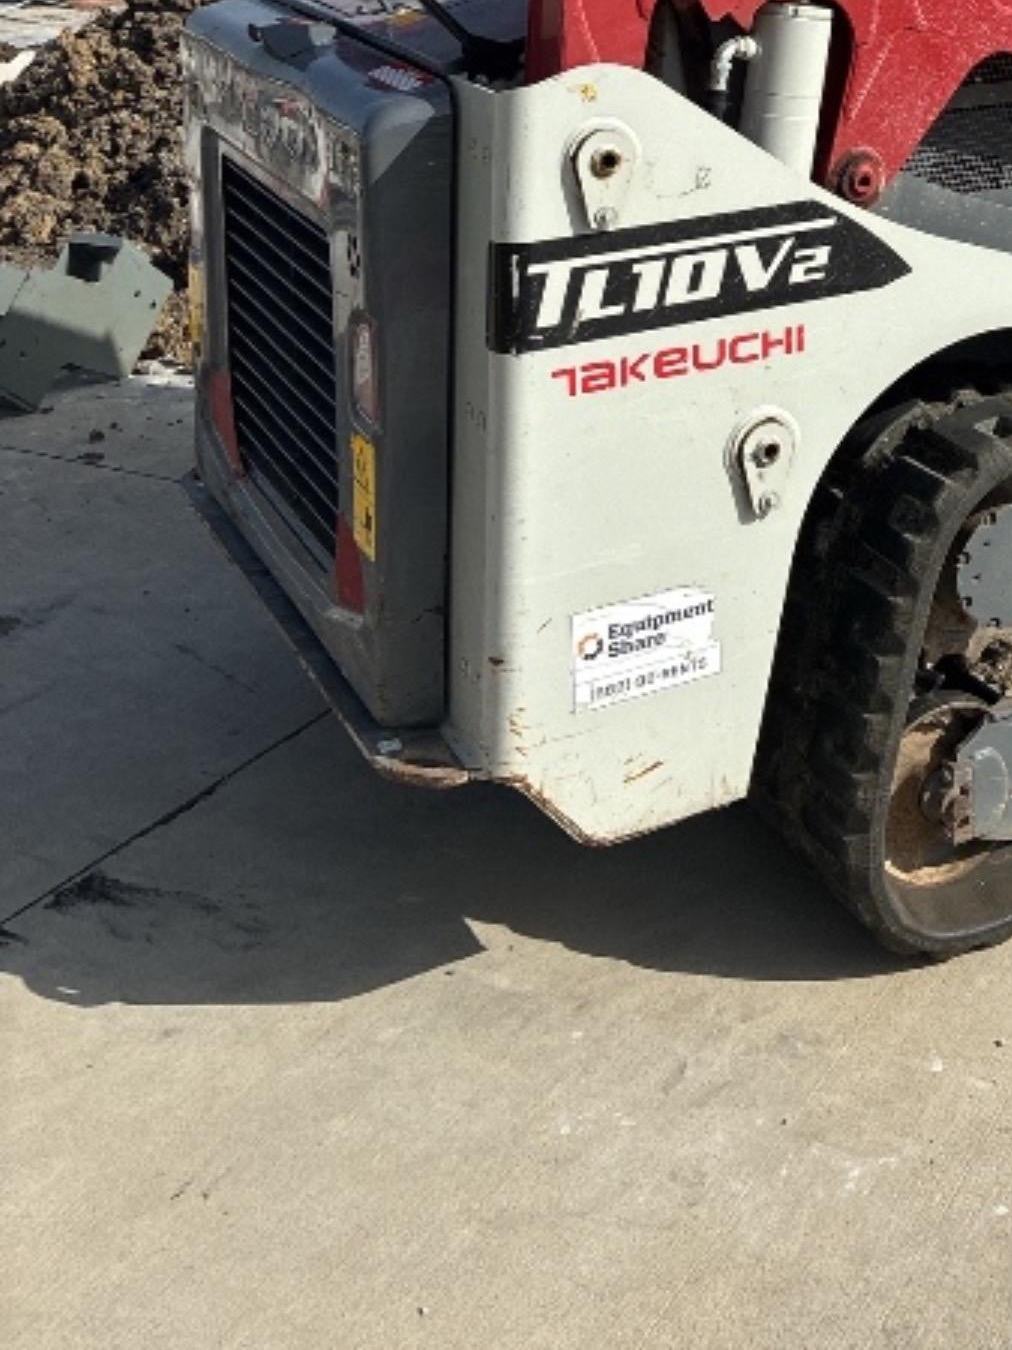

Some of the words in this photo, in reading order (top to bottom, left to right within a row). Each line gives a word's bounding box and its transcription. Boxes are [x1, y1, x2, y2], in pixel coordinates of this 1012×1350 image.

[551, 323, 806, 397] TAKEUCHI
[607, 598, 715, 640] Equipment
[607, 631, 668, 658] Share
